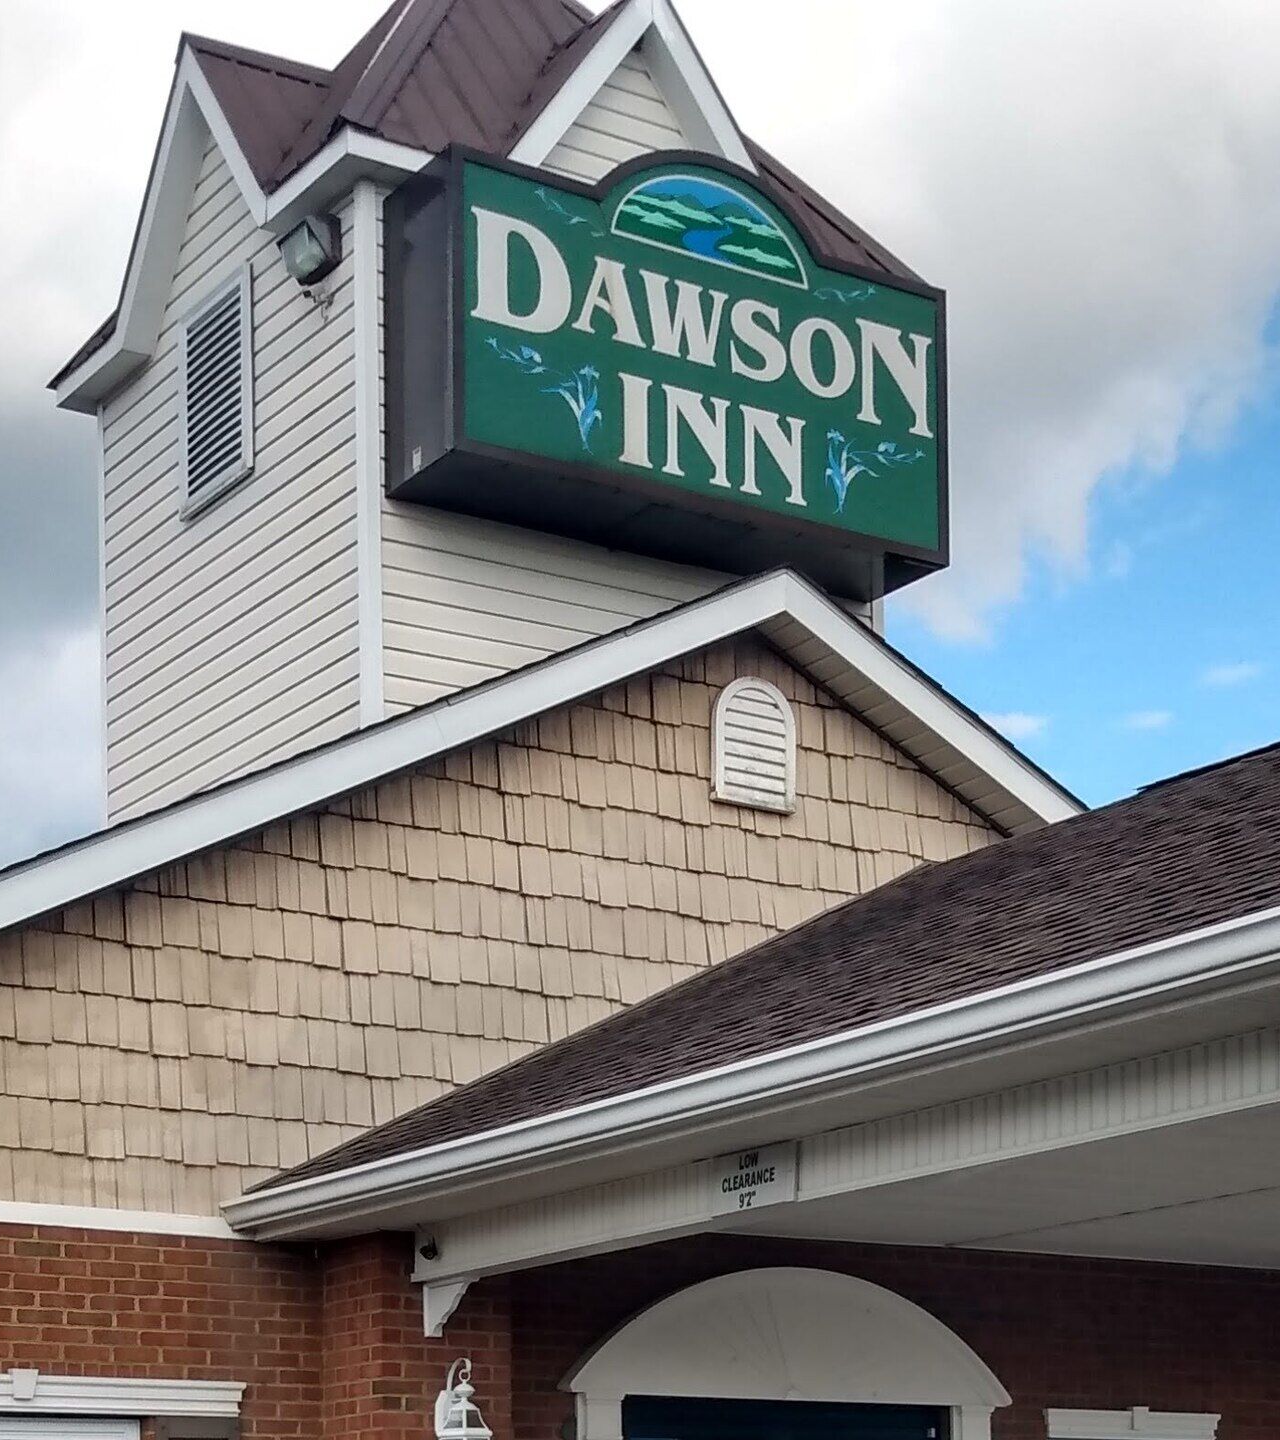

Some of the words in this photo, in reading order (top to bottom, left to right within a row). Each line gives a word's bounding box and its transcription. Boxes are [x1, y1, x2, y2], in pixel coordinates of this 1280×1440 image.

[470, 206, 933, 438] DAWSON
[618, 372, 806, 505] INN
[722, 1167, 775, 1193] CLEARANCE
[738, 1152, 758, 1170] LOW
